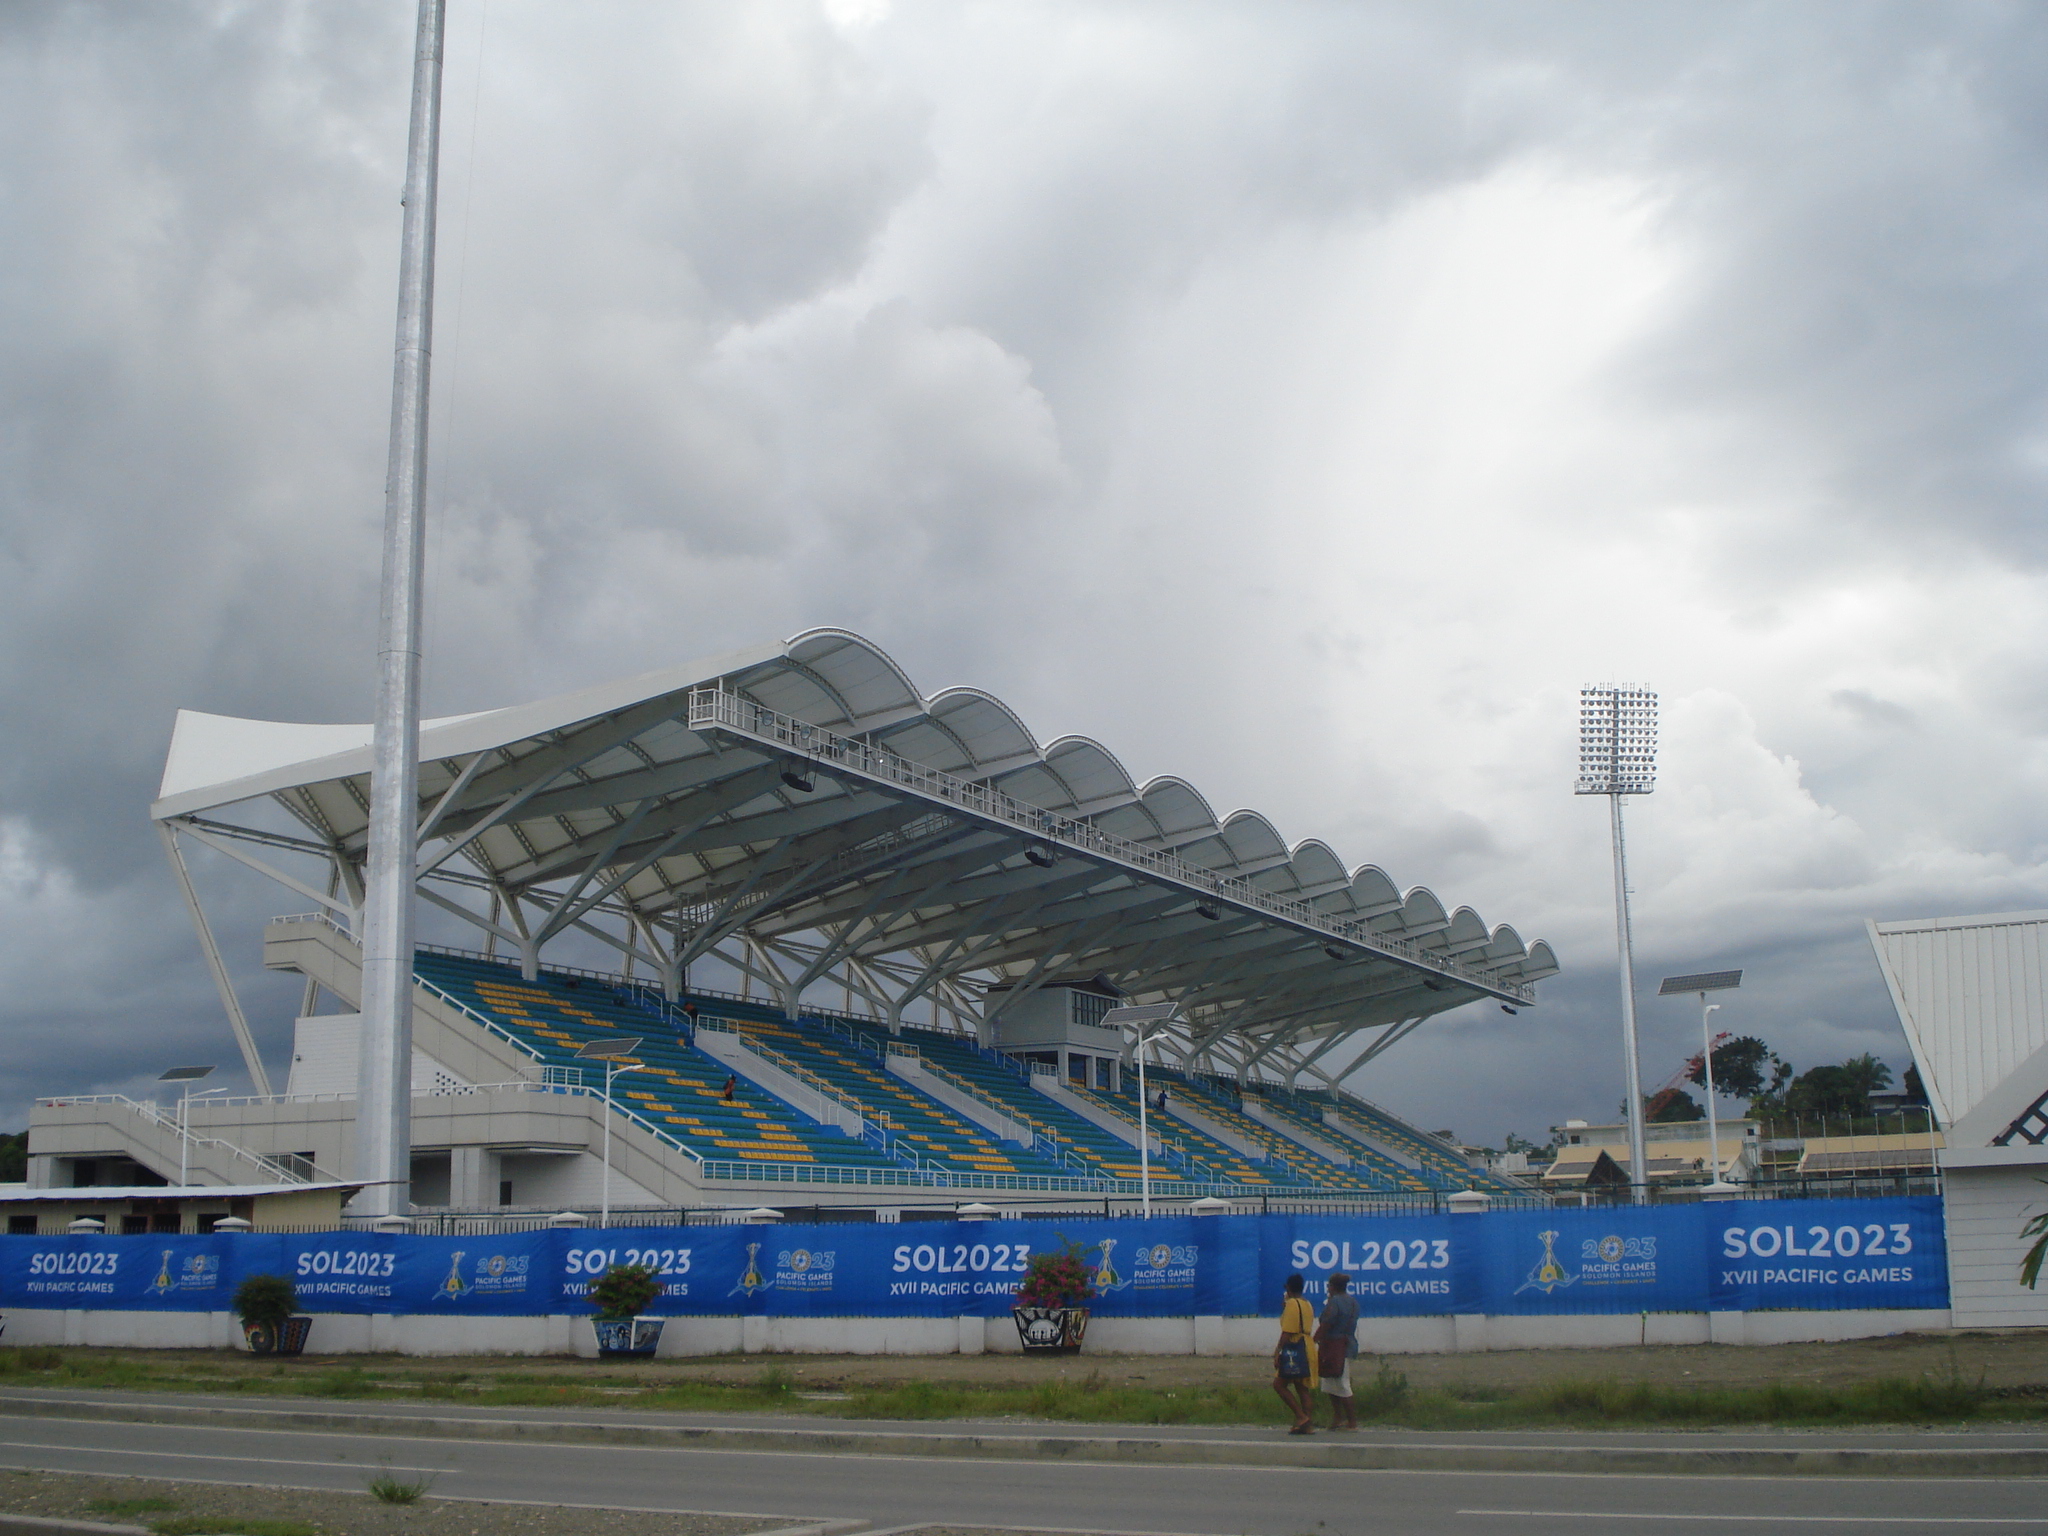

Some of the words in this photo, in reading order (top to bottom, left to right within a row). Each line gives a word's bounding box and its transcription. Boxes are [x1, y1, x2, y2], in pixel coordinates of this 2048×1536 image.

[1581, 1235, 1657, 1263] 2023
[1722, 1223, 1913, 1259] SOL2023
[29, 1252, 119, 1275] SOL2023
[296, 1250, 396, 1277] SOL2023
[776, 1249, 836, 1272] 2023
[892, 1244, 1031, 1273] SOL2023
[1134, 1244, 1199, 1269] 2023
[1291, 1239, 1450, 1271] SOL2023
[476, 1255, 530, 1277] 2023
[776, 1271, 806, 1281] PACIFIC
[808, 1272, 833, 1281] GAMES
[1134, 1269, 1166, 1278] PACIFIC
[1168, 1268, 1196, 1277] GAMES
[1582, 1263, 1621, 1272] PACIFIC
[1622, 1261, 1656, 1271] GAMES
[503, 1275, 527, 1284] GAMES
[1721, 1269, 1757, 1286] XVII
[1763, 1268, 1838, 1284] PACIFIC
[1843, 1267, 1913, 1284] GAMES
[26, 1281, 45, 1292] XVII
[77, 1282, 114, 1294] GAMES
[294, 1282, 314, 1295] XVII
[316, 1282, 356, 1295] PACIFIC
[357, 1284, 392, 1297] GAMES
[889, 1281, 916, 1296] XVII
[920, 1281, 970, 1296] PACIFIC
[1324, 1281, 1387, 1295] PCIFIC
[1391, 1280, 1450, 1294] GAMES
